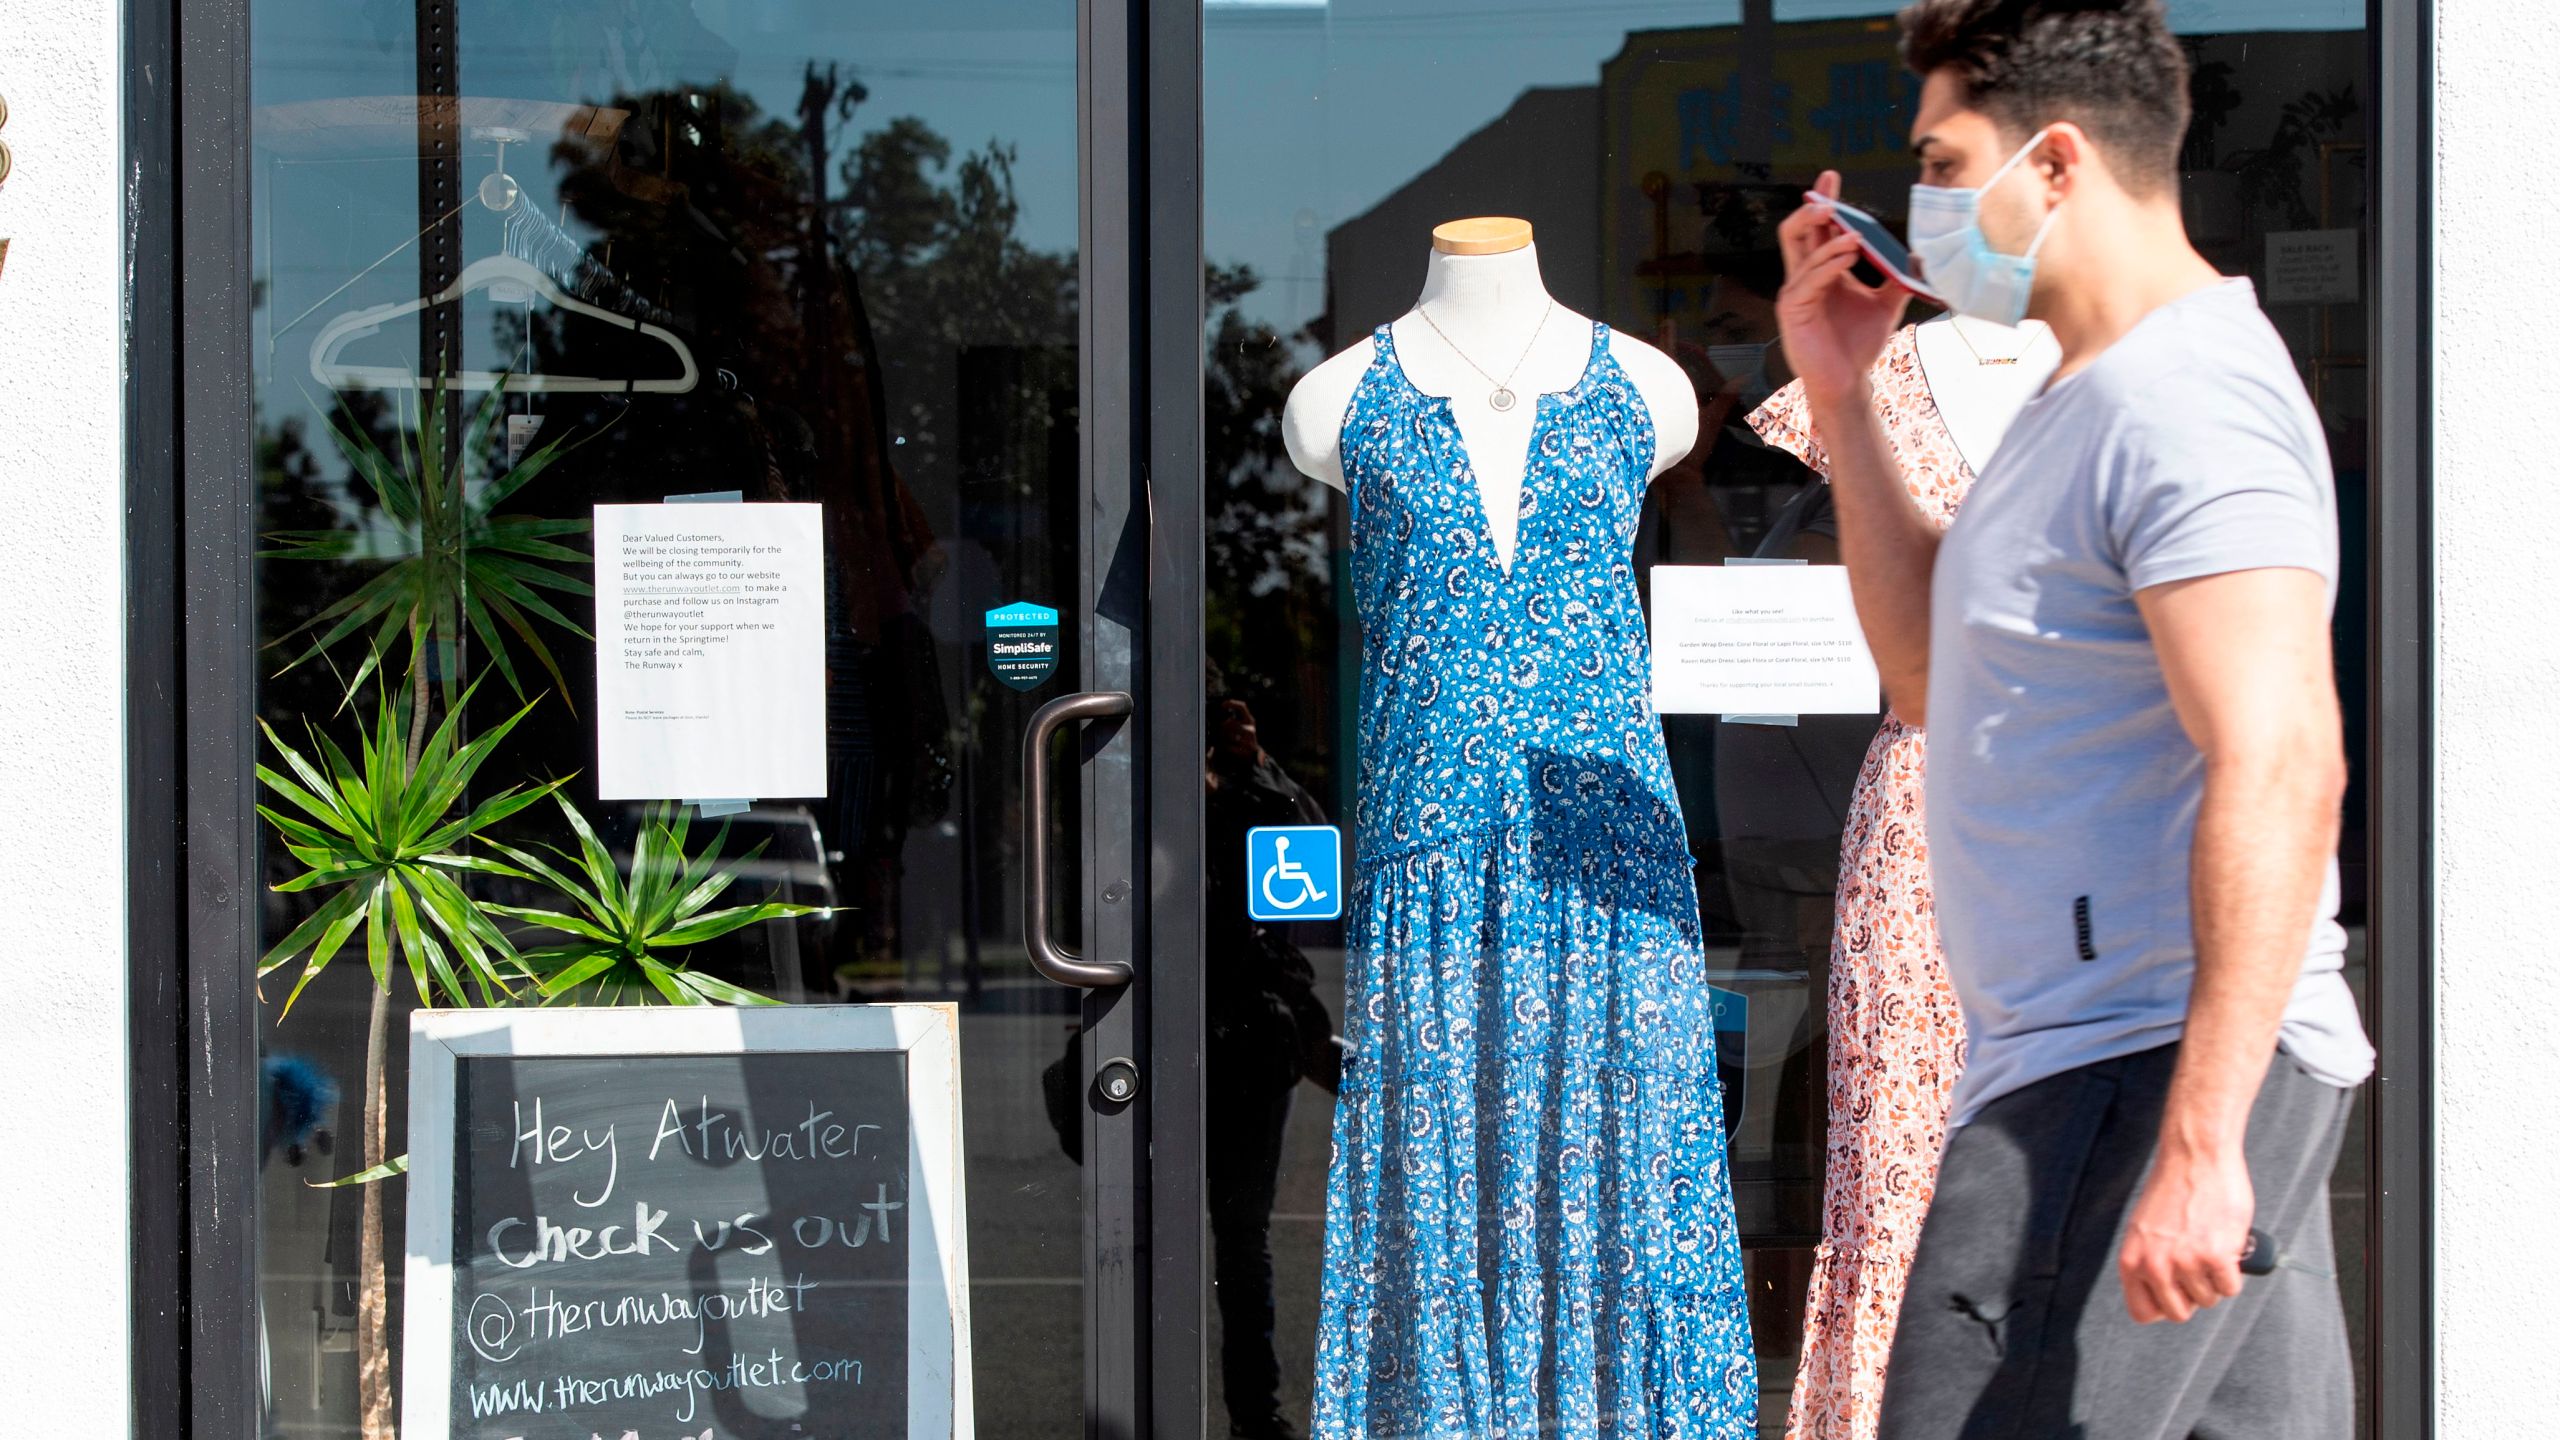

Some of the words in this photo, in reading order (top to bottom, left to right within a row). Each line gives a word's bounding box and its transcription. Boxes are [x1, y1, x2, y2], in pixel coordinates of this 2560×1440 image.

[645, 534, 674, 542] Valued
[677, 534, 724, 542] Customers,
[639, 547, 653, 555] will
[669, 547, 698, 556] closing
[701, 546, 750, 555] temporarily
[623, 560, 663, 569] wellbeing
[666, 559, 674, 567] of
[693, 559, 743, 568] community.
[640, 574, 655, 582] you
[675, 572, 703, 581] always
[704, 573, 716, 582] go
[747, 571, 780, 579] website
[624, 585, 740, 595] www.therunwayoutlet.com
[624, 598, 661, 607] purchase
[683, 597, 708, 605] follow
[737, 597, 779, 606] Instagram
[624, 610, 703, 619] @therunwayoutlet
[641, 623, 662, 632] hope
[736, 622, 759, 630] when
[680, 635, 728, 645] Springtime!
[625, 649, 642, 657] Stay
[645, 648, 661, 656] safe
[664, 648, 679, 656] and
[682, 648, 704, 656] calm,
[993, 642, 1051, 655] SimpliSafe
[624, 661, 640, 669] The
[643, 661, 675, 669] Runway
[510, 1097, 617, 1208] Hey
[690, 1211, 774, 1255] us
[792, 1183, 904, 1249] out
[467, 1273, 819, 1362] @therunwayoutlet
[472, 1348, 862, 1422] www.therunwayoutlet.com
